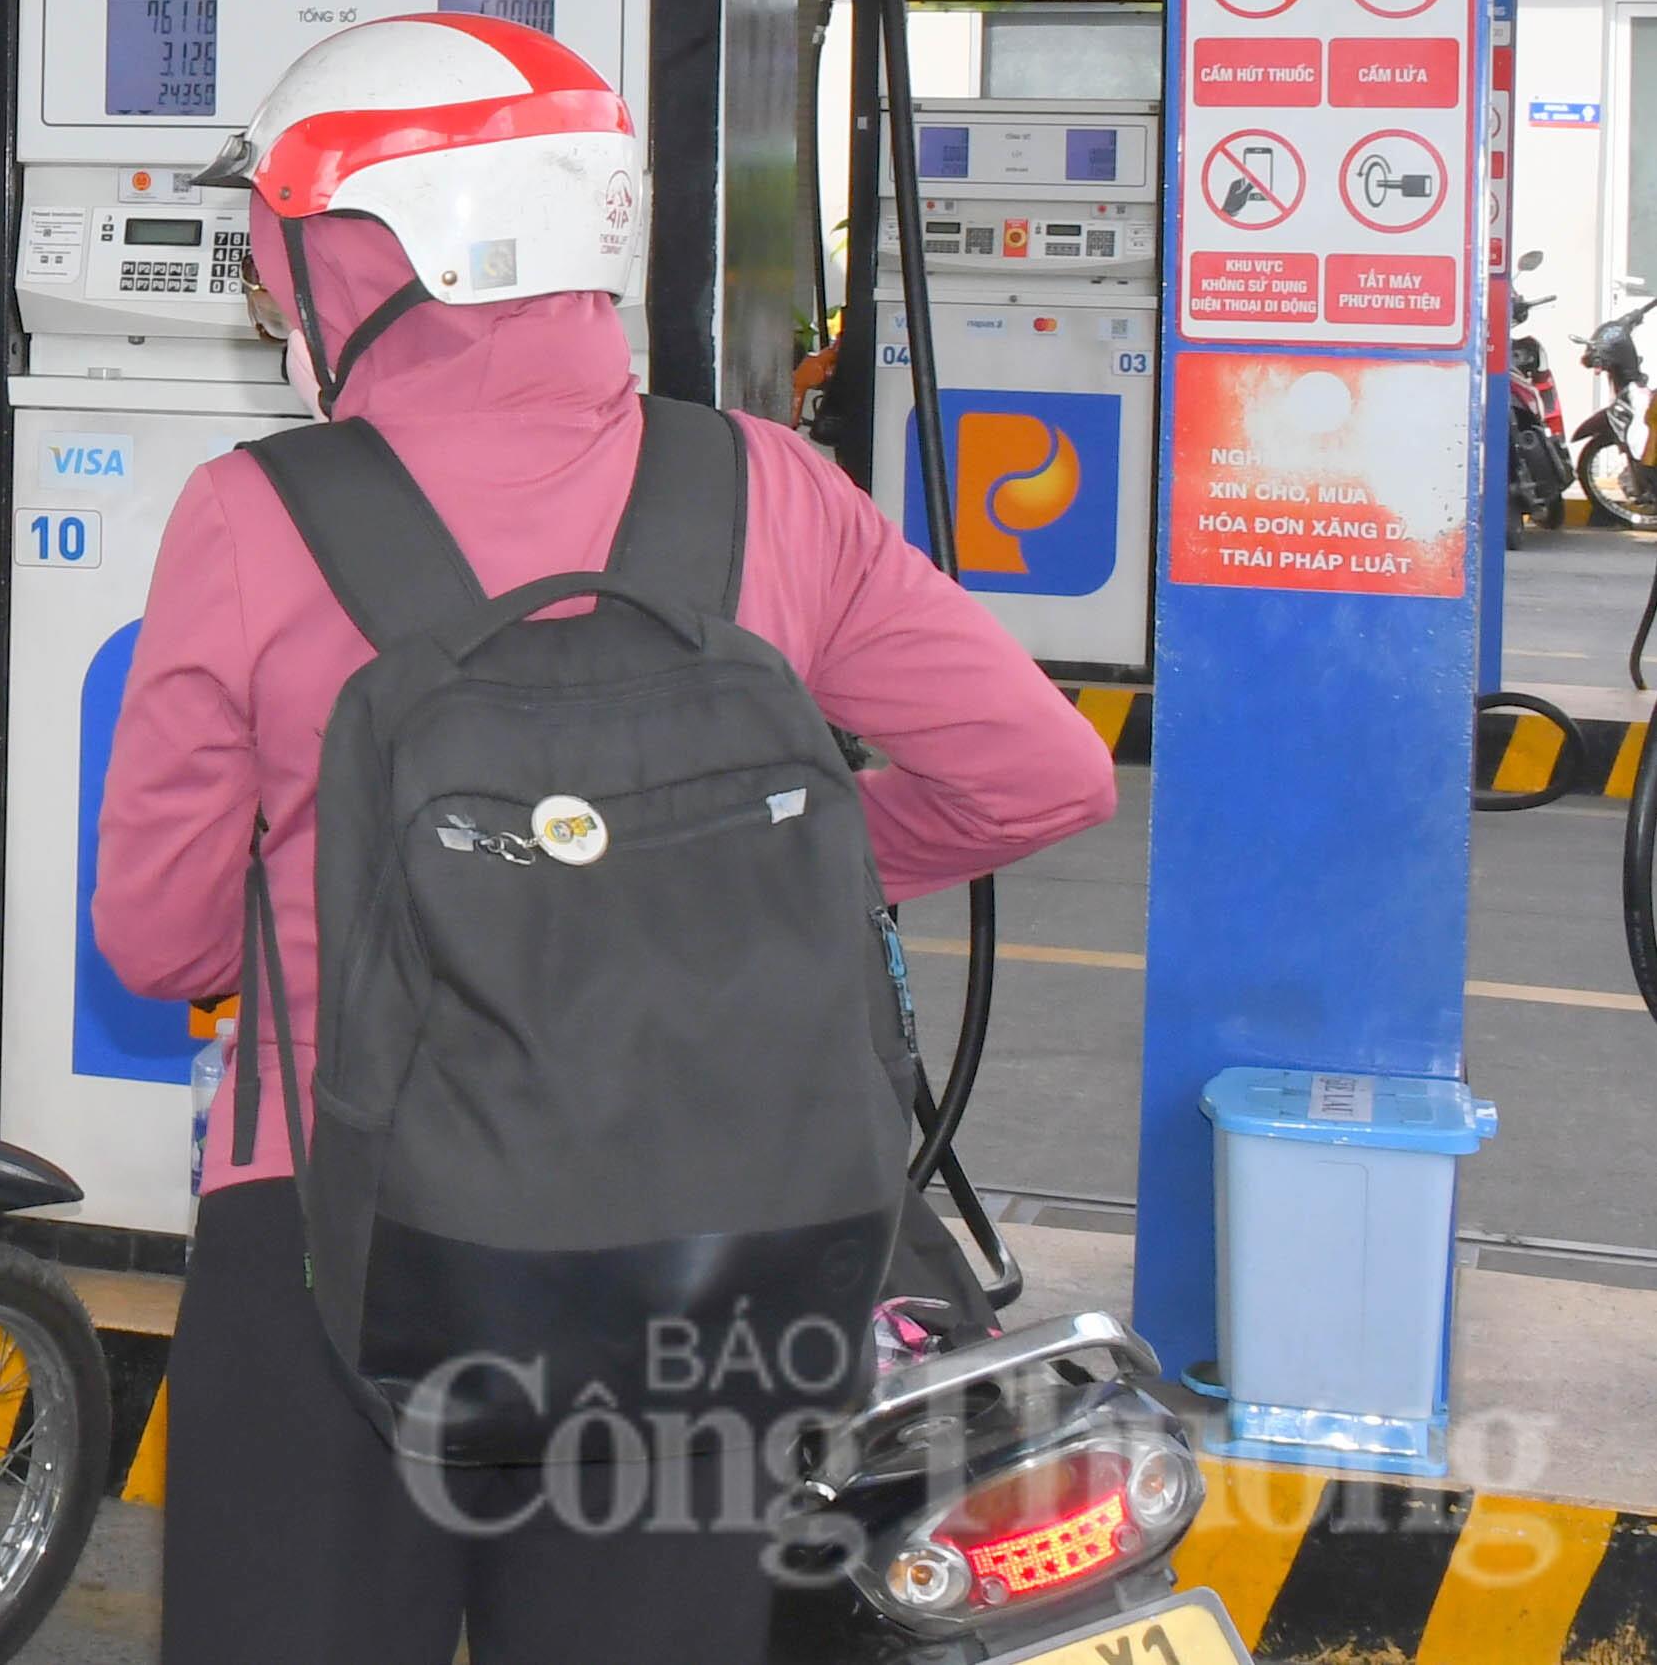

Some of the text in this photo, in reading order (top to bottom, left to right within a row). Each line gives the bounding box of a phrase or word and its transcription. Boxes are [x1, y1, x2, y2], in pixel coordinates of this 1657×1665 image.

[297, 7, 357, 23] TỔNG SỐ
[1200, 63, 1315, 83] CẤM HÚT THUỐC
[1358, 63, 1428, 83] CẤM LỬA
[122, 264, 135, 274] P1
[138, 264, 151, 274] P2
[1225, 259, 1284, 274] KHU VỰC
[228, 282, 238, 293] C
[1201, 276, 1245, 292] KHÔNG
[1272, 280, 1308, 295] DỤNG
[1358, 267, 1422, 290] TẮT MÁY
[1191, 297, 1317, 315] ĐIỆN THOẠI DI ĐỘNG
[1339, 292, 1441, 311] PHƯƠNG TIỆN
[883, 346, 910, 366] 04
[1119, 353, 1146, 372] 03
[49, 446, 125, 476] VISA
[1208, 482, 1369, 505] XIN CHO, MUA
[1198, 511, 1248, 534] HÓA
[1254, 515, 1305, 535] ĐƠN
[1311, 516, 1378, 539] XĂNG
[31, 516, 85, 561] 10
[1219, 546, 1412, 578] TRÁI PHÁP LUẬT
